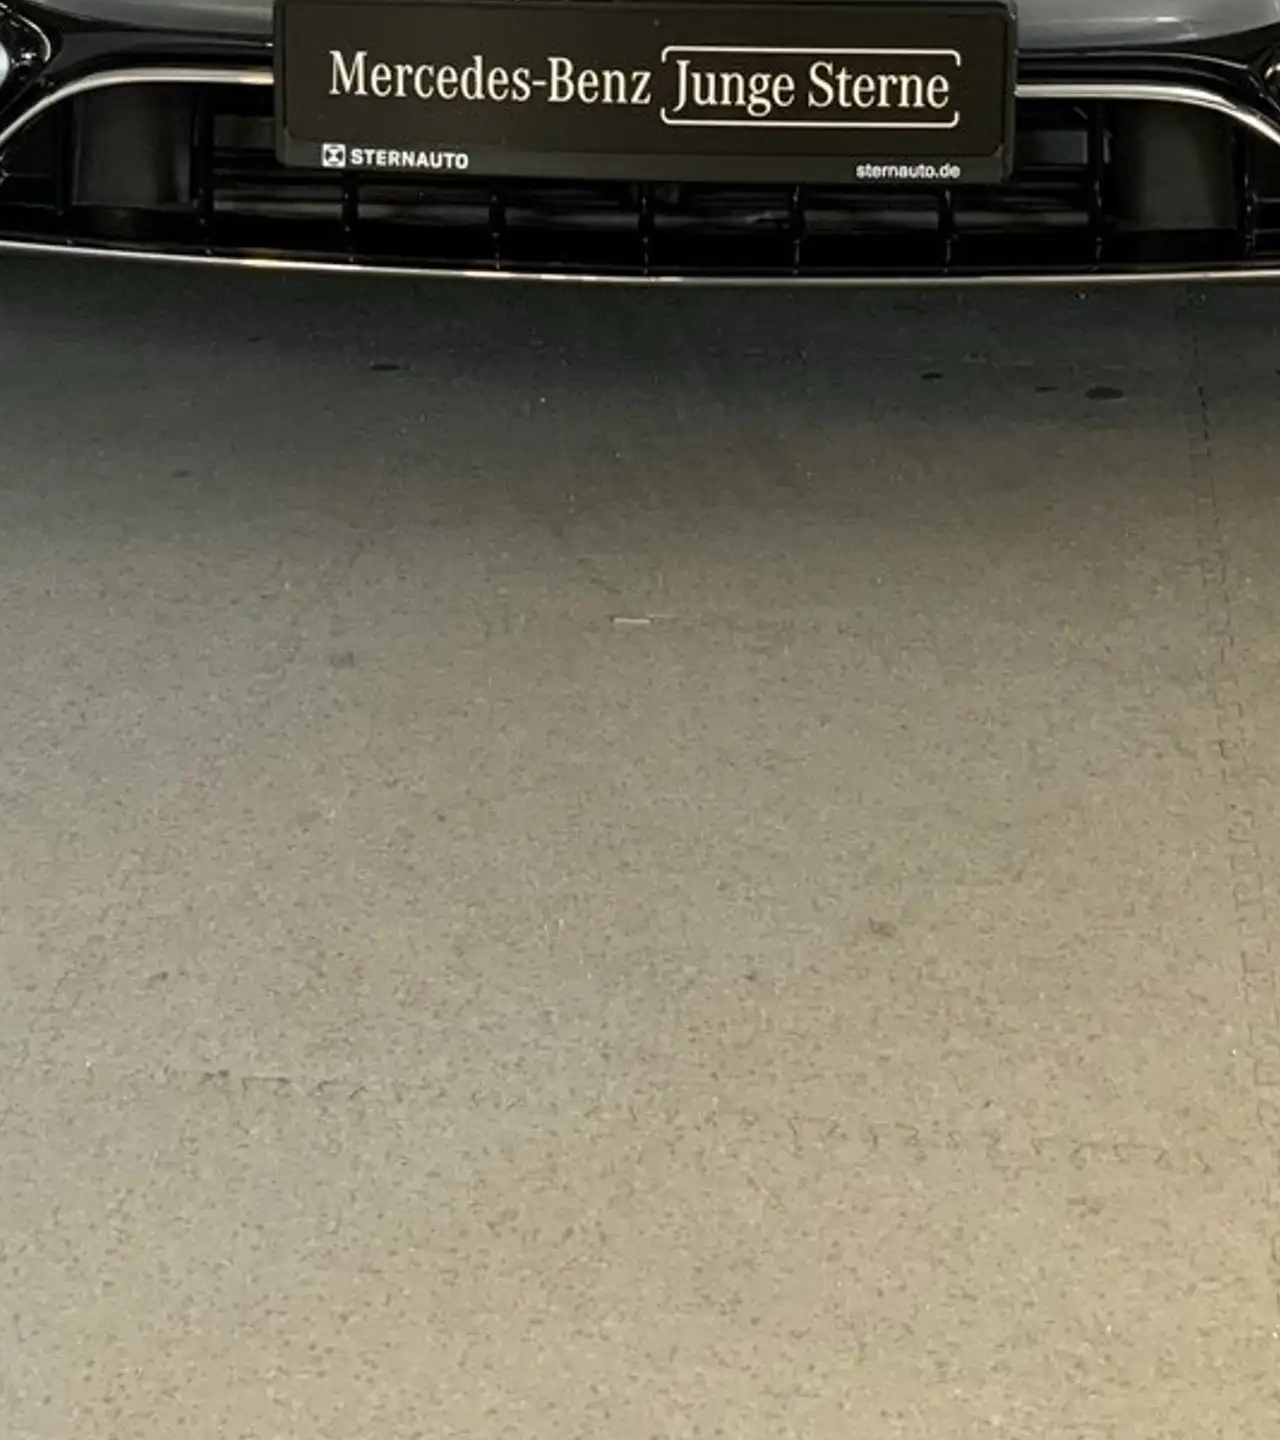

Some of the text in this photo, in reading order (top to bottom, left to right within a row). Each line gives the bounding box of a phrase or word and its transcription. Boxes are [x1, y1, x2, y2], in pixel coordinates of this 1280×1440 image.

[328, 49, 950, 117] Mercedes-Benz Junge Sterne
[349, 147, 470, 170] STERNAUTO
[855, 162, 962, 180] sternauto.de
